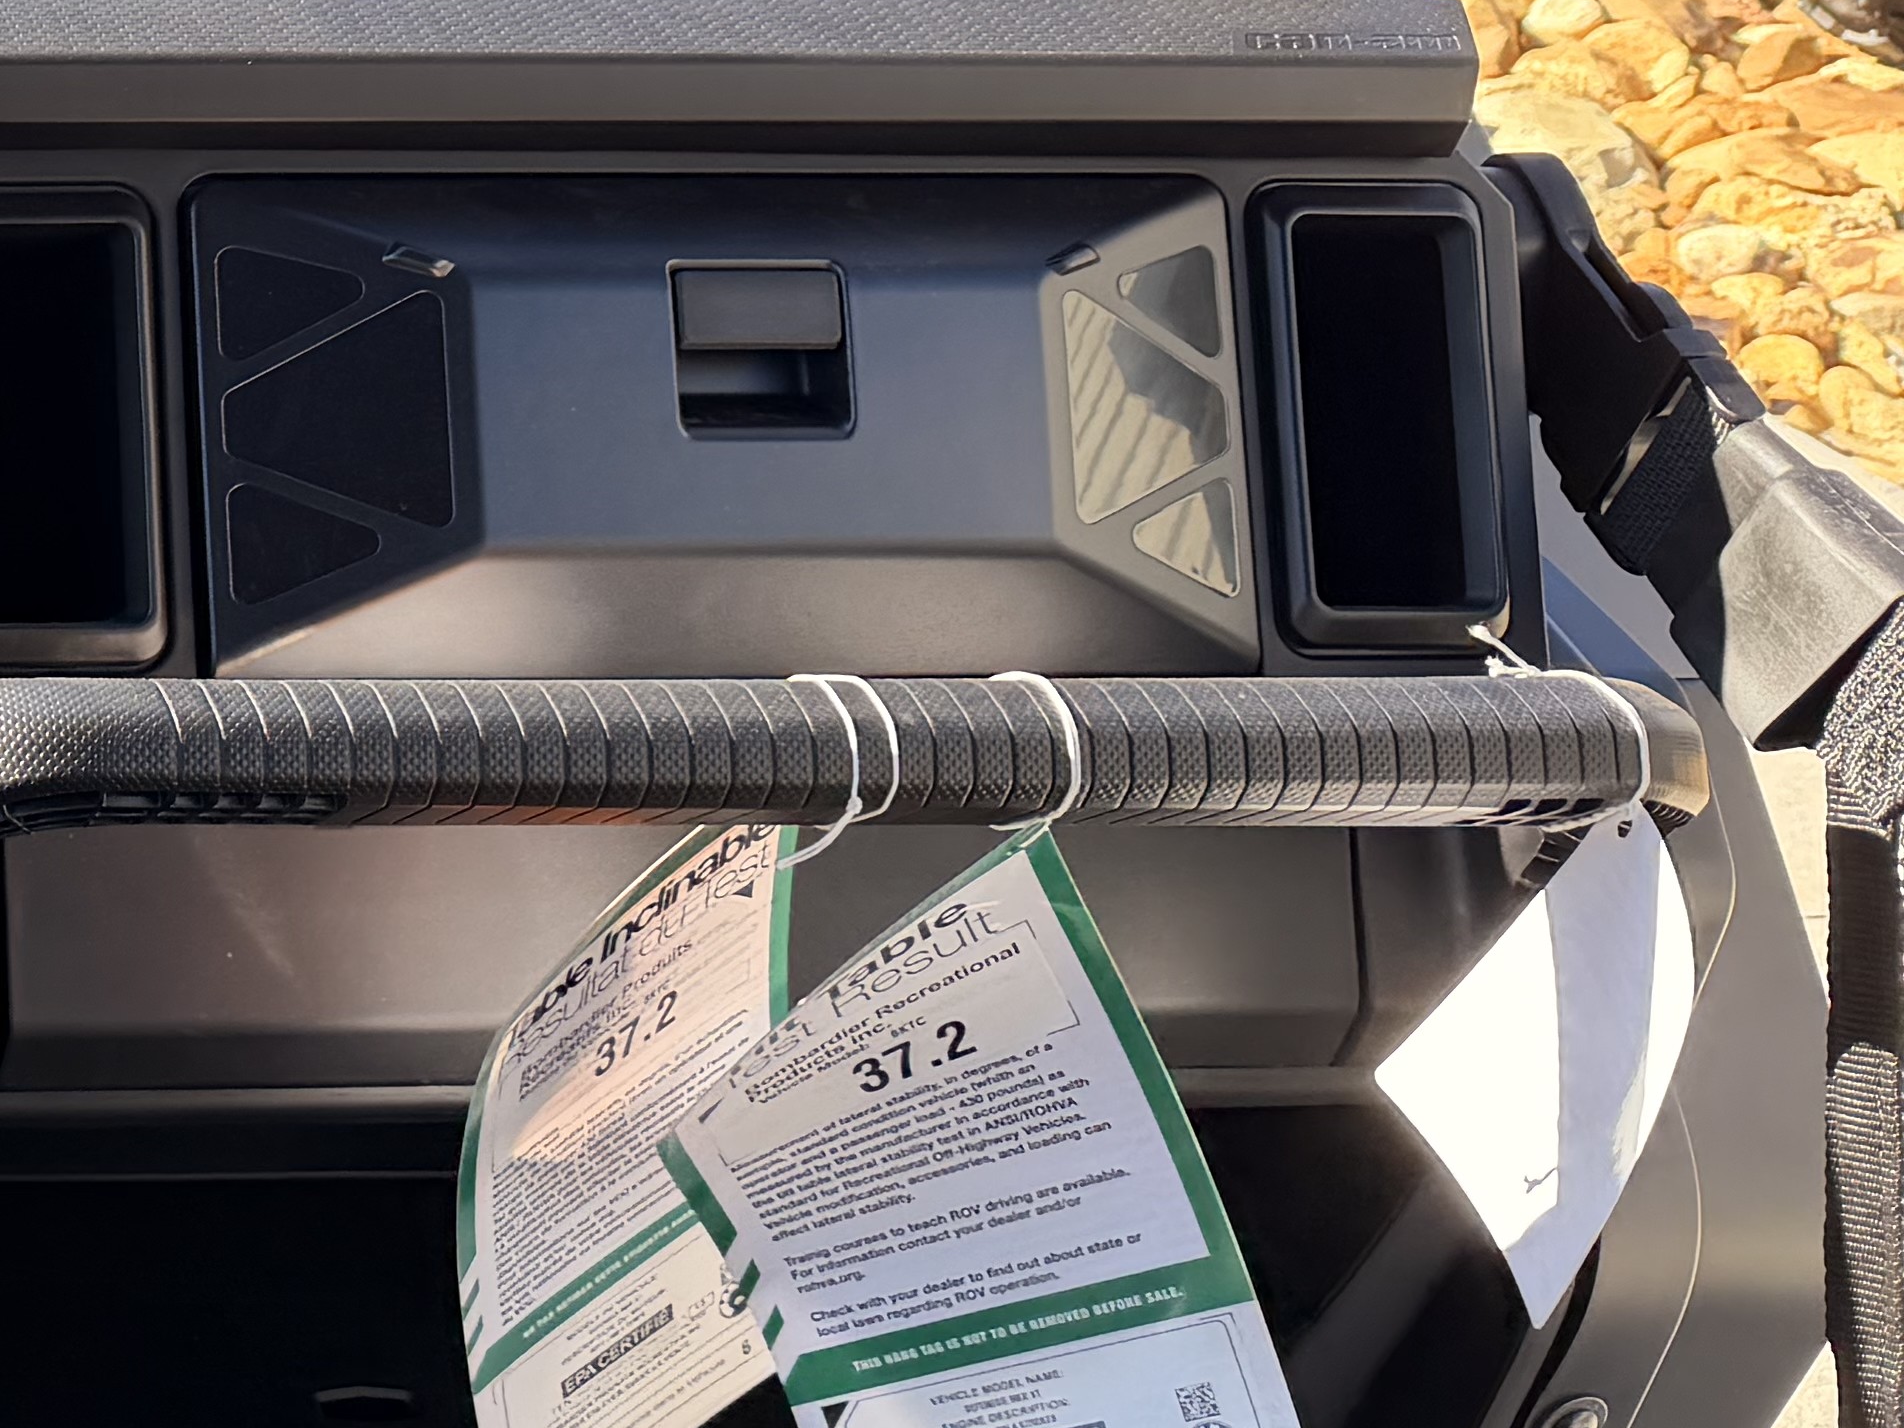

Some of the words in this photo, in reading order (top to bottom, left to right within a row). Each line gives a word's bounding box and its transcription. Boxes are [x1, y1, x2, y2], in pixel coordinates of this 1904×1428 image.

[621, 938, 693, 999] Produits
[818, 902, 968, 1002] Table
[830, 910, 995, 1018] Result
[594, 989, 678, 1078] 37.2
[744, 1017, 870, 1095] Bombardier
[875, 941, 1021, 1020] Recreational
[852, 1020, 978, 1093] 37.2
[748, 1044, 846, 1103] Products
[851, 1022, 894, 1046] Inc.
[839, 1103, 884, 1125] lateral
[944, 1075, 958, 1086] in
[1025, 1045, 1041, 1057] of
[1043, 1043, 1053, 1052] a
[851, 1104, 917, 1134] condition
[918, 1086, 969, 1109] vehicle
[1018, 1063, 1036, 1075] an
[954, 1114, 970, 1125] in
[972, 1089, 1056, 1121] accordance
[1057, 1077, 1090, 1094] with
[840, 1120, 912, 1152] passenger
[914, 1106, 947, 1124] load
[987, 1074, 1045, 1102] pounds)
[1047, 1070, 1066, 1082] as
[759, 1193, 819, 1220] standard
[820, 1185, 841, 1199] for
[842, 1157, 931, 1192] Recreational
[932, 1131, 1021, 1163] Off-Highway
[815, 1180, 906, 1214] modification,
[907, 1154, 996, 1186] accessories,
[998, 1143, 1026, 1160] and
[1027, 1128, 1082, 1151] loading
[1084, 1120, 1112, 1137] can
[833, 1158, 878, 1180] lateral
[936, 1130, 965, 1146] test
[967, 1125, 982, 1137] in
[790, 1267, 814, 1281] For
[897, 1229, 952, 1252] contact
[953, 1221, 985, 1239] your
[987, 1208, 1032, 1228] dealer
[1035, 1195, 1082, 1216] and/or
[812, 1206, 857, 1229] lateral
[858, 1192, 916, 1215] stability.
[833, 1232, 889, 1254] courses
[889, 1226, 906, 1238] to
[907, 1215, 948, 1233] teach
[949, 1203, 981, 1224] ROV
[984, 1191, 1034, 1213] driving
[1036, 1184, 1060, 1200] are
[1062, 1167, 1132, 1192] available.
[810, 1303, 855, 1323] Check
[856, 1295, 888, 1311] with
[887, 1288, 919, 1305] your
[922, 1274, 966, 1295] dealer
[968, 1272, 984, 1284] to
[986, 1262, 1015, 1278] find
[1016, 1256, 1041, 1272] out
[1043, 1246, 1085, 1265] about
[1087, 1236, 1124, 1254] state
[1126, 1232, 1142, 1244] or
[816, 1320, 851, 1338] local
[886, 1296, 954, 1322] regarding
[954, 1286, 985, 1304] ROV
[989, 1271, 1061, 1296] operation.
[852, 1354, 883, 1373] THIS
[919, 1340, 945, 1357] TAG
[947, 1336, 962, 1351] IS
[962, 1330, 989, 1347] NOT
[989, 1325, 1008, 1340] TO
[1009, 1321, 1028, 1336] BE
[1028, 1306, 1091, 1332] REMOVED
[1092, 1294, 1143, 1317] BEFORE
[1144, 1284, 1186, 1306] SALE.
[929, 1387, 979, 1408] VEHICLE
[980, 1378, 1024, 1396] MODEL
